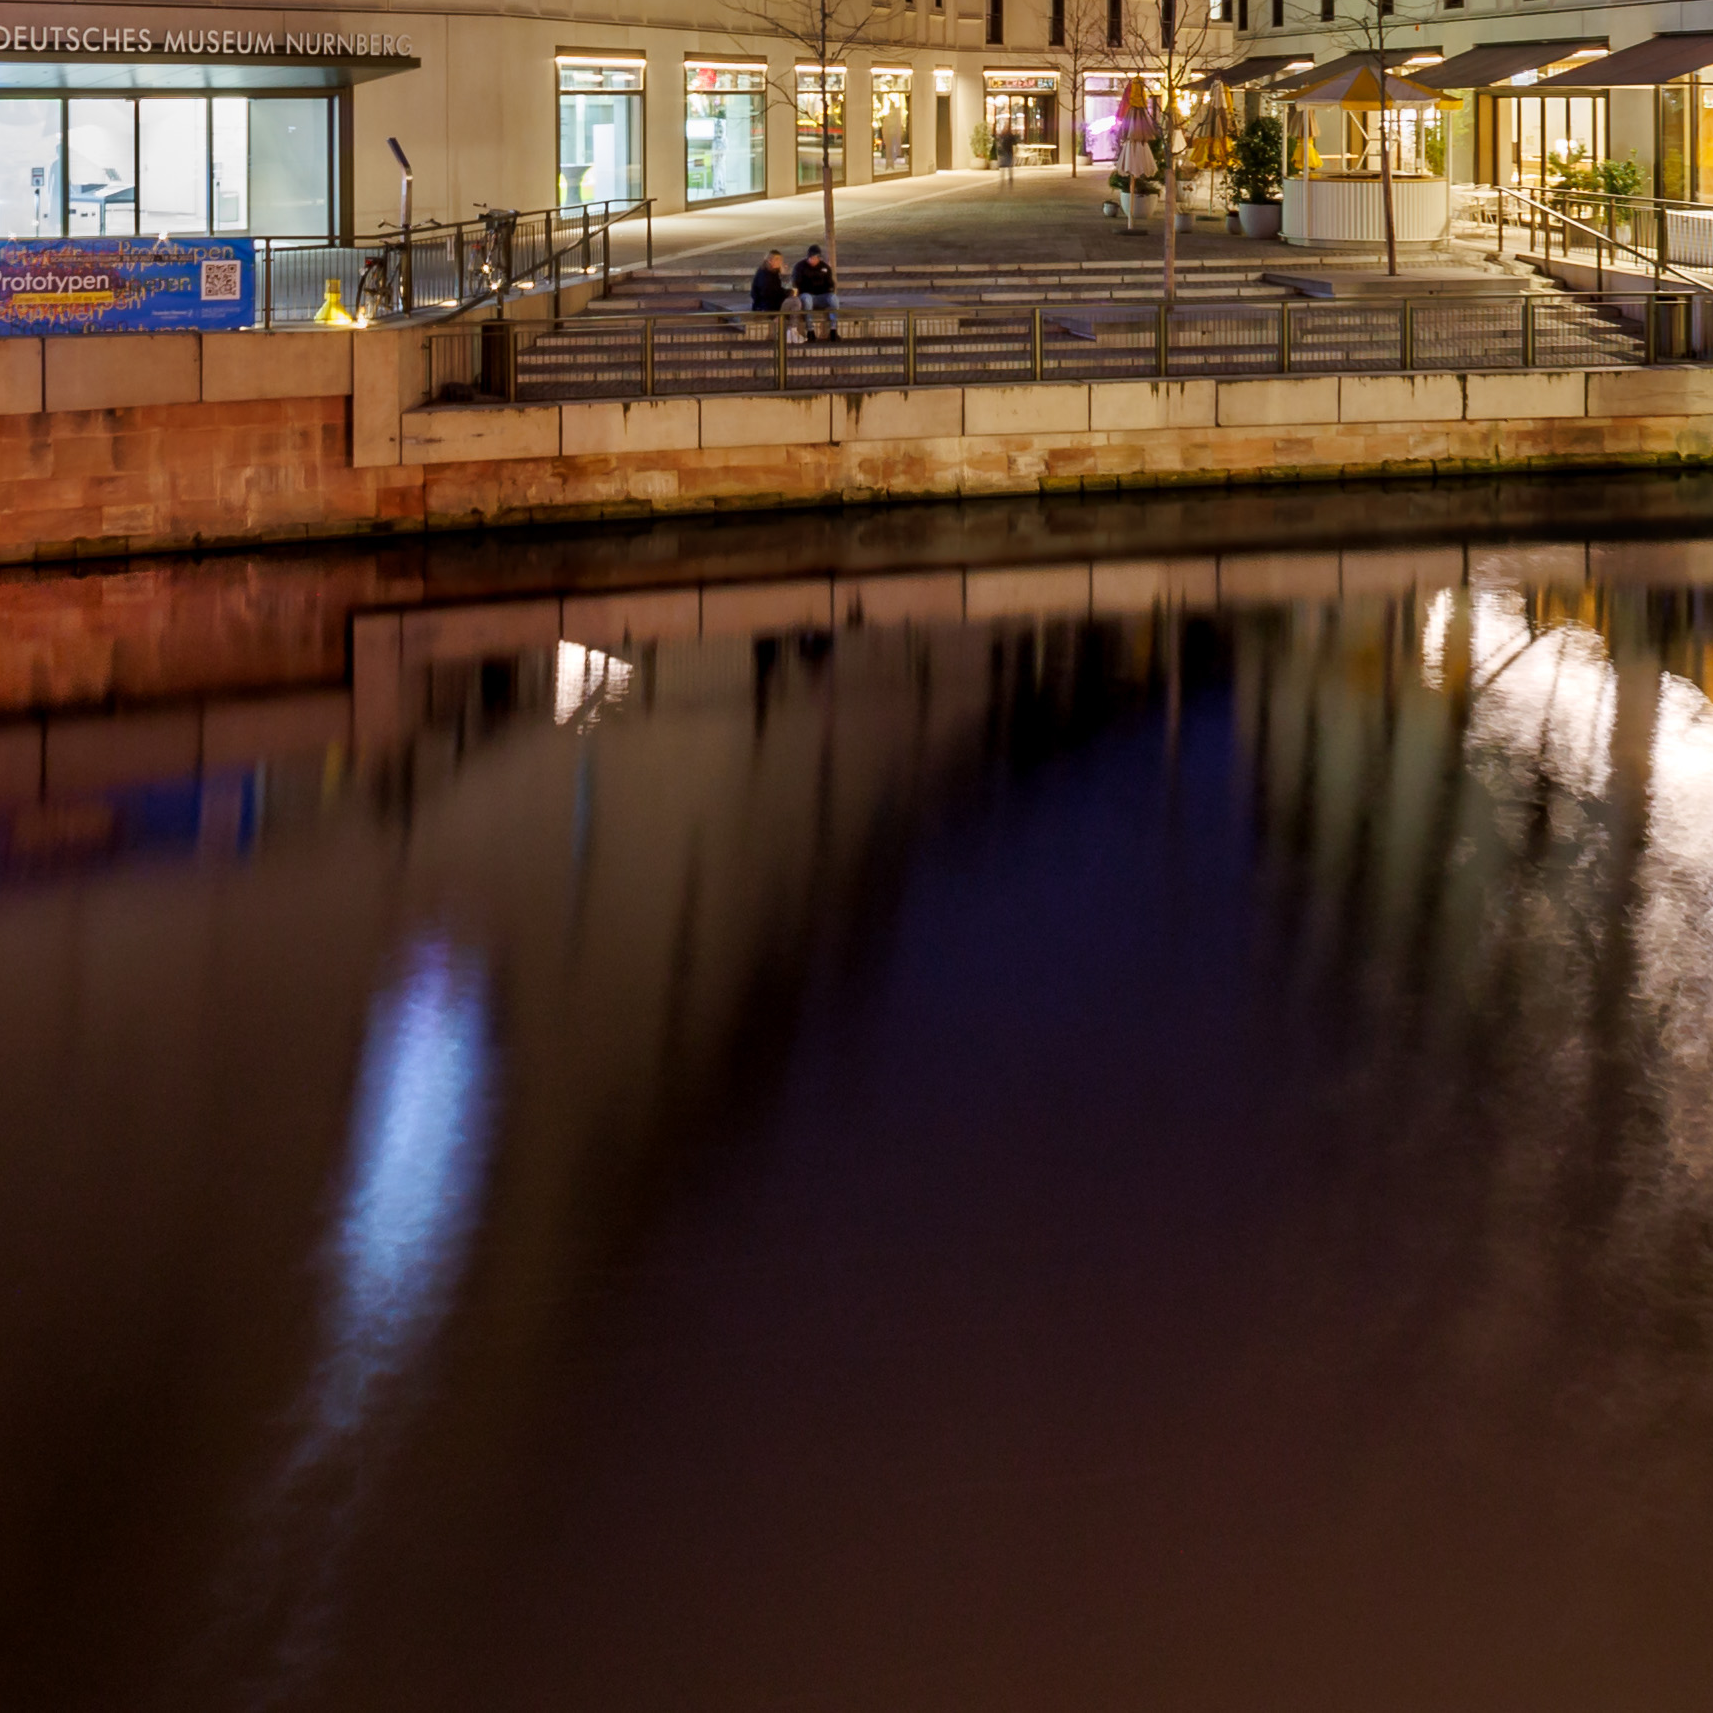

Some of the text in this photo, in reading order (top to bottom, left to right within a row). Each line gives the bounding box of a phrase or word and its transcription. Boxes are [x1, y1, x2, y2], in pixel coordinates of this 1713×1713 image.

[164, 30, 275, 55] MUSEUM
[1006, 78, 1035, 88] CREAM
[1038, 78, 1053, 88] BAR
